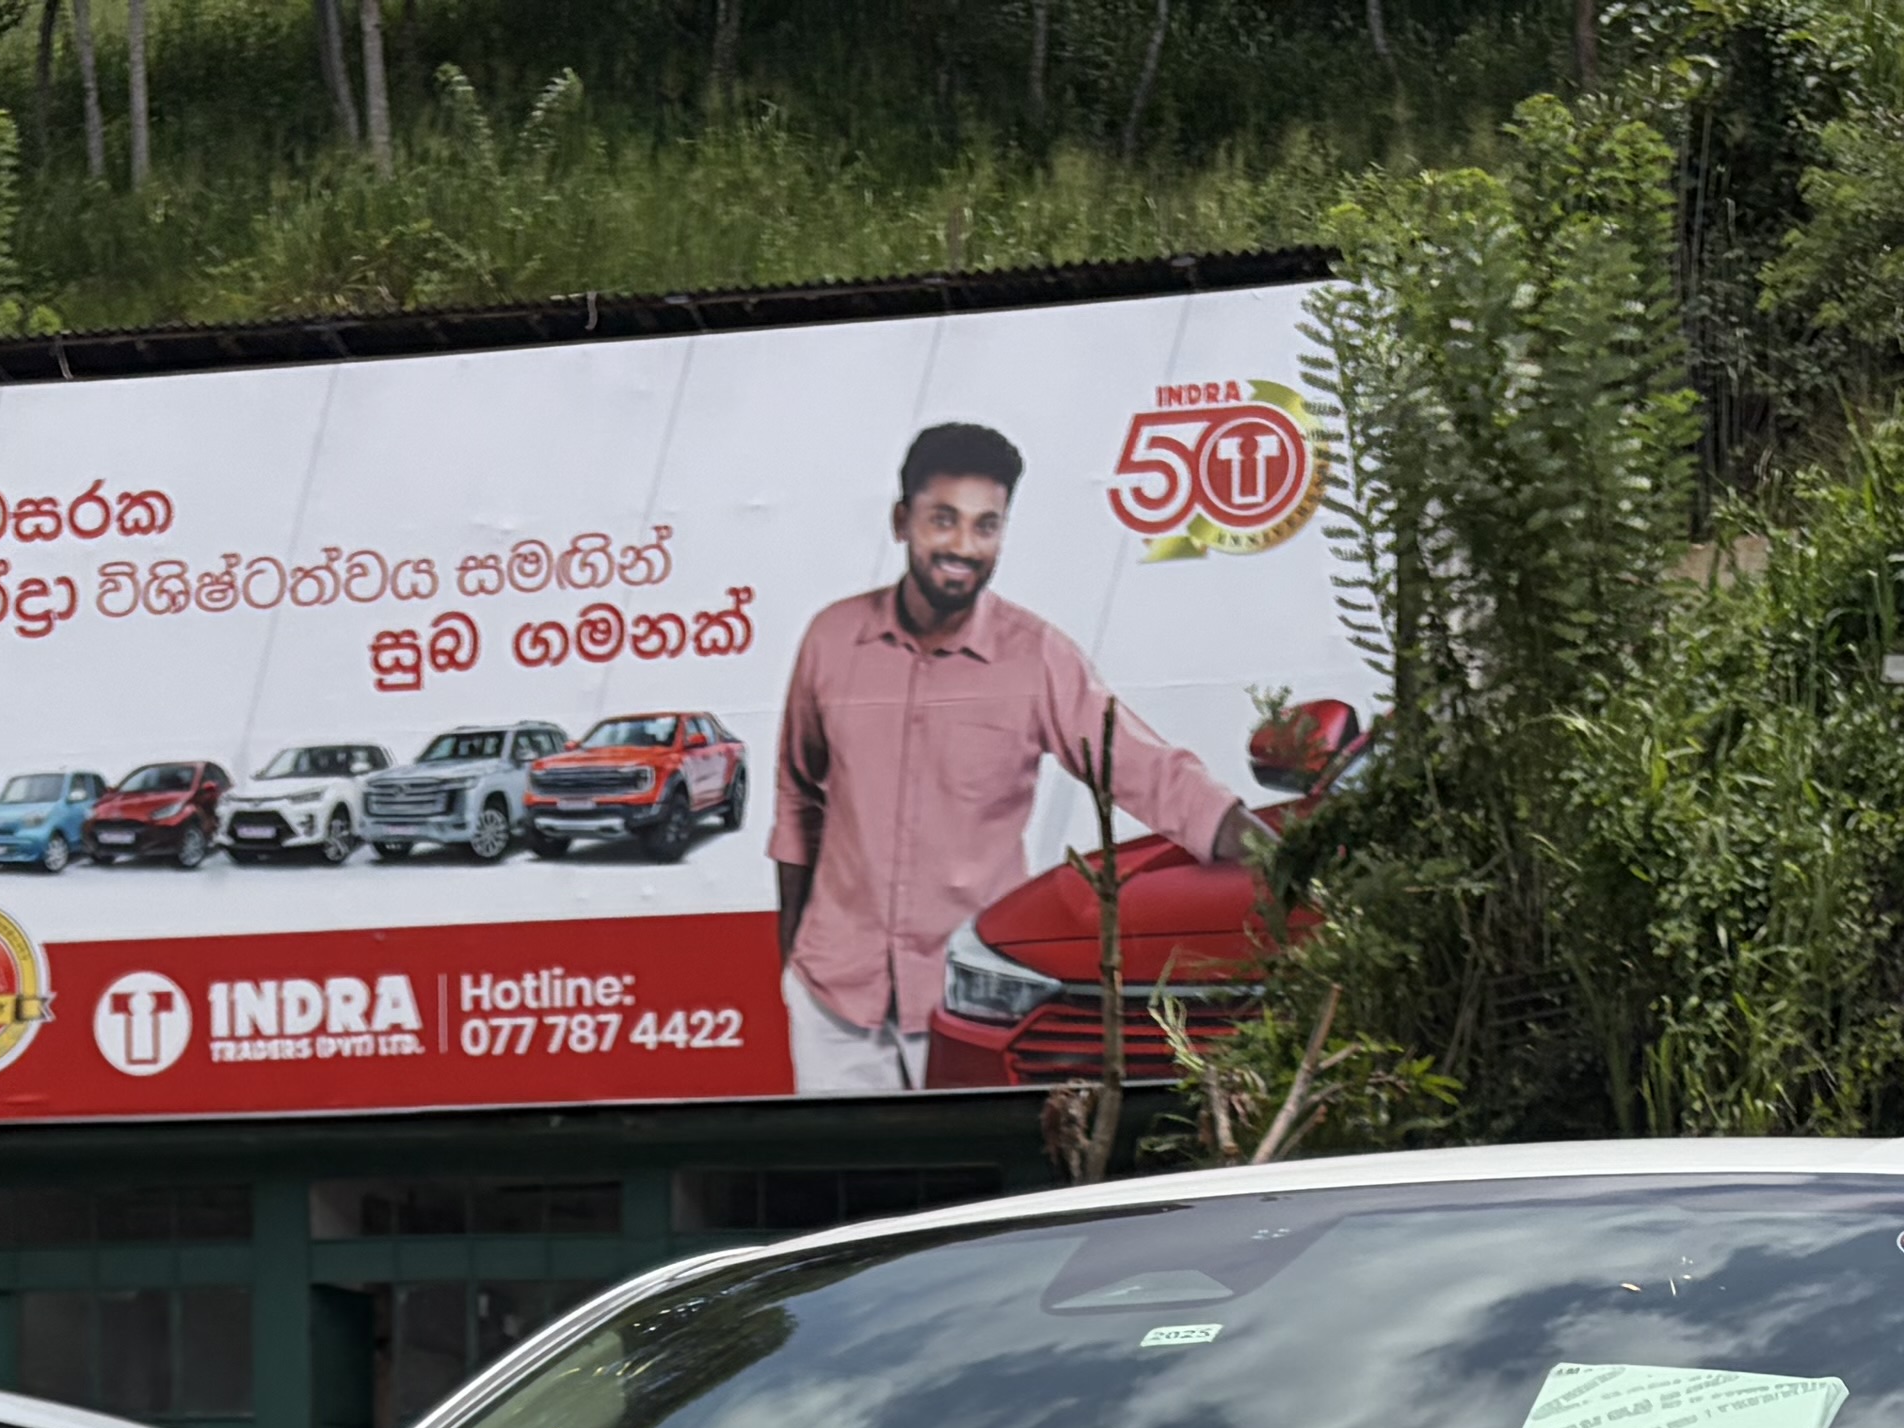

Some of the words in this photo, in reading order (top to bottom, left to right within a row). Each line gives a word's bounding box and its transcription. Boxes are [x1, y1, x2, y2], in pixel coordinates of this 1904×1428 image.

[1156, 380, 1242, 407] INDRA
[513, 586, 755, 668] ගමනක්
[208, 974, 423, 1037] INDRA
[460, 965, 636, 1011] Hotline:
[210, 1038, 312, 1062] TRADERS
[460, 1016, 537, 1056] 077
[543, 1013, 622, 1054] 787
[629, 1008, 744, 1050] 4422
